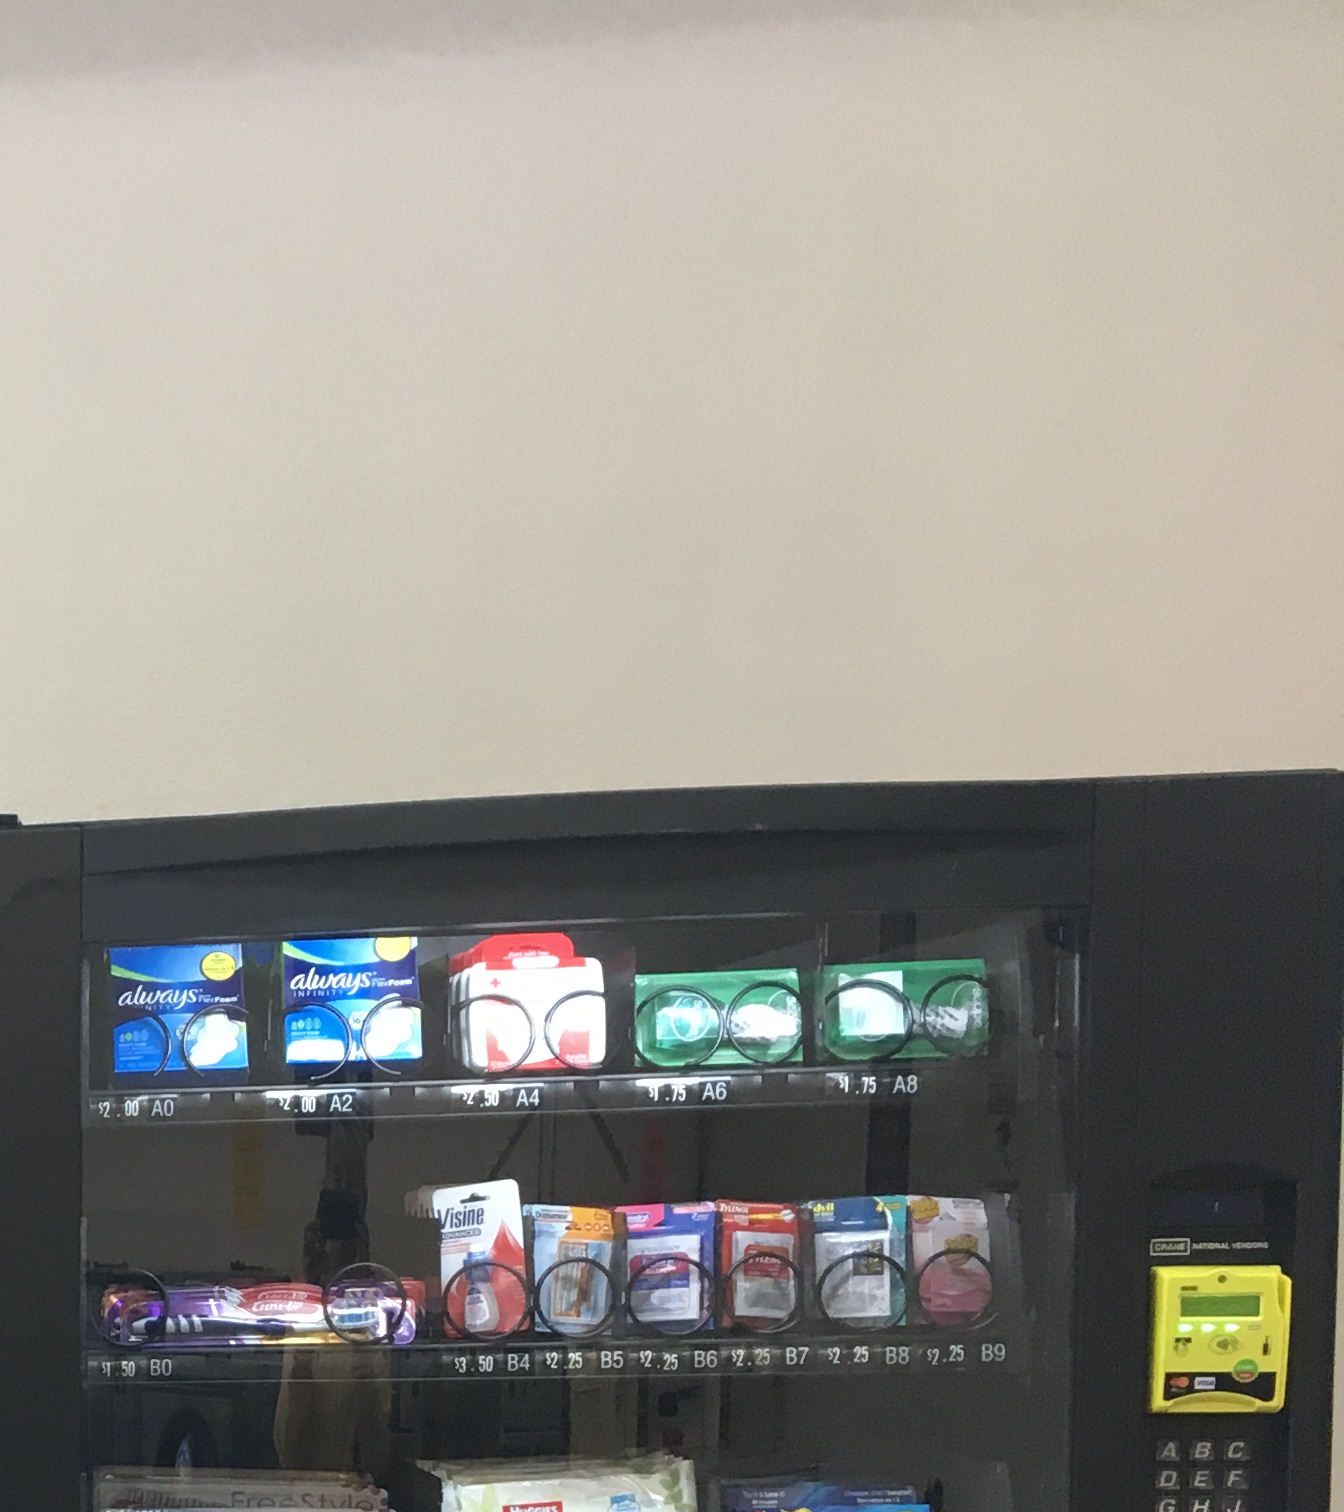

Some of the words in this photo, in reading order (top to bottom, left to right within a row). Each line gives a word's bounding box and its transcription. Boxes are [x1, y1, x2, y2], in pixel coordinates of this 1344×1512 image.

[289, 965, 373, 991] always
[118, 984, 199, 1007] always
[702, 1085, 727, 1101] A6
[893, 1075, 918, 1094] A8
[151, 1098, 174, 1117] A0
[329, 1095, 353, 1113] A2
[516, 1088, 540, 1108] A4
[437, 1206, 485, 1230] Visine
[507, 1354, 530, 1371] B4
[785, 1346, 810, 1365] B7
